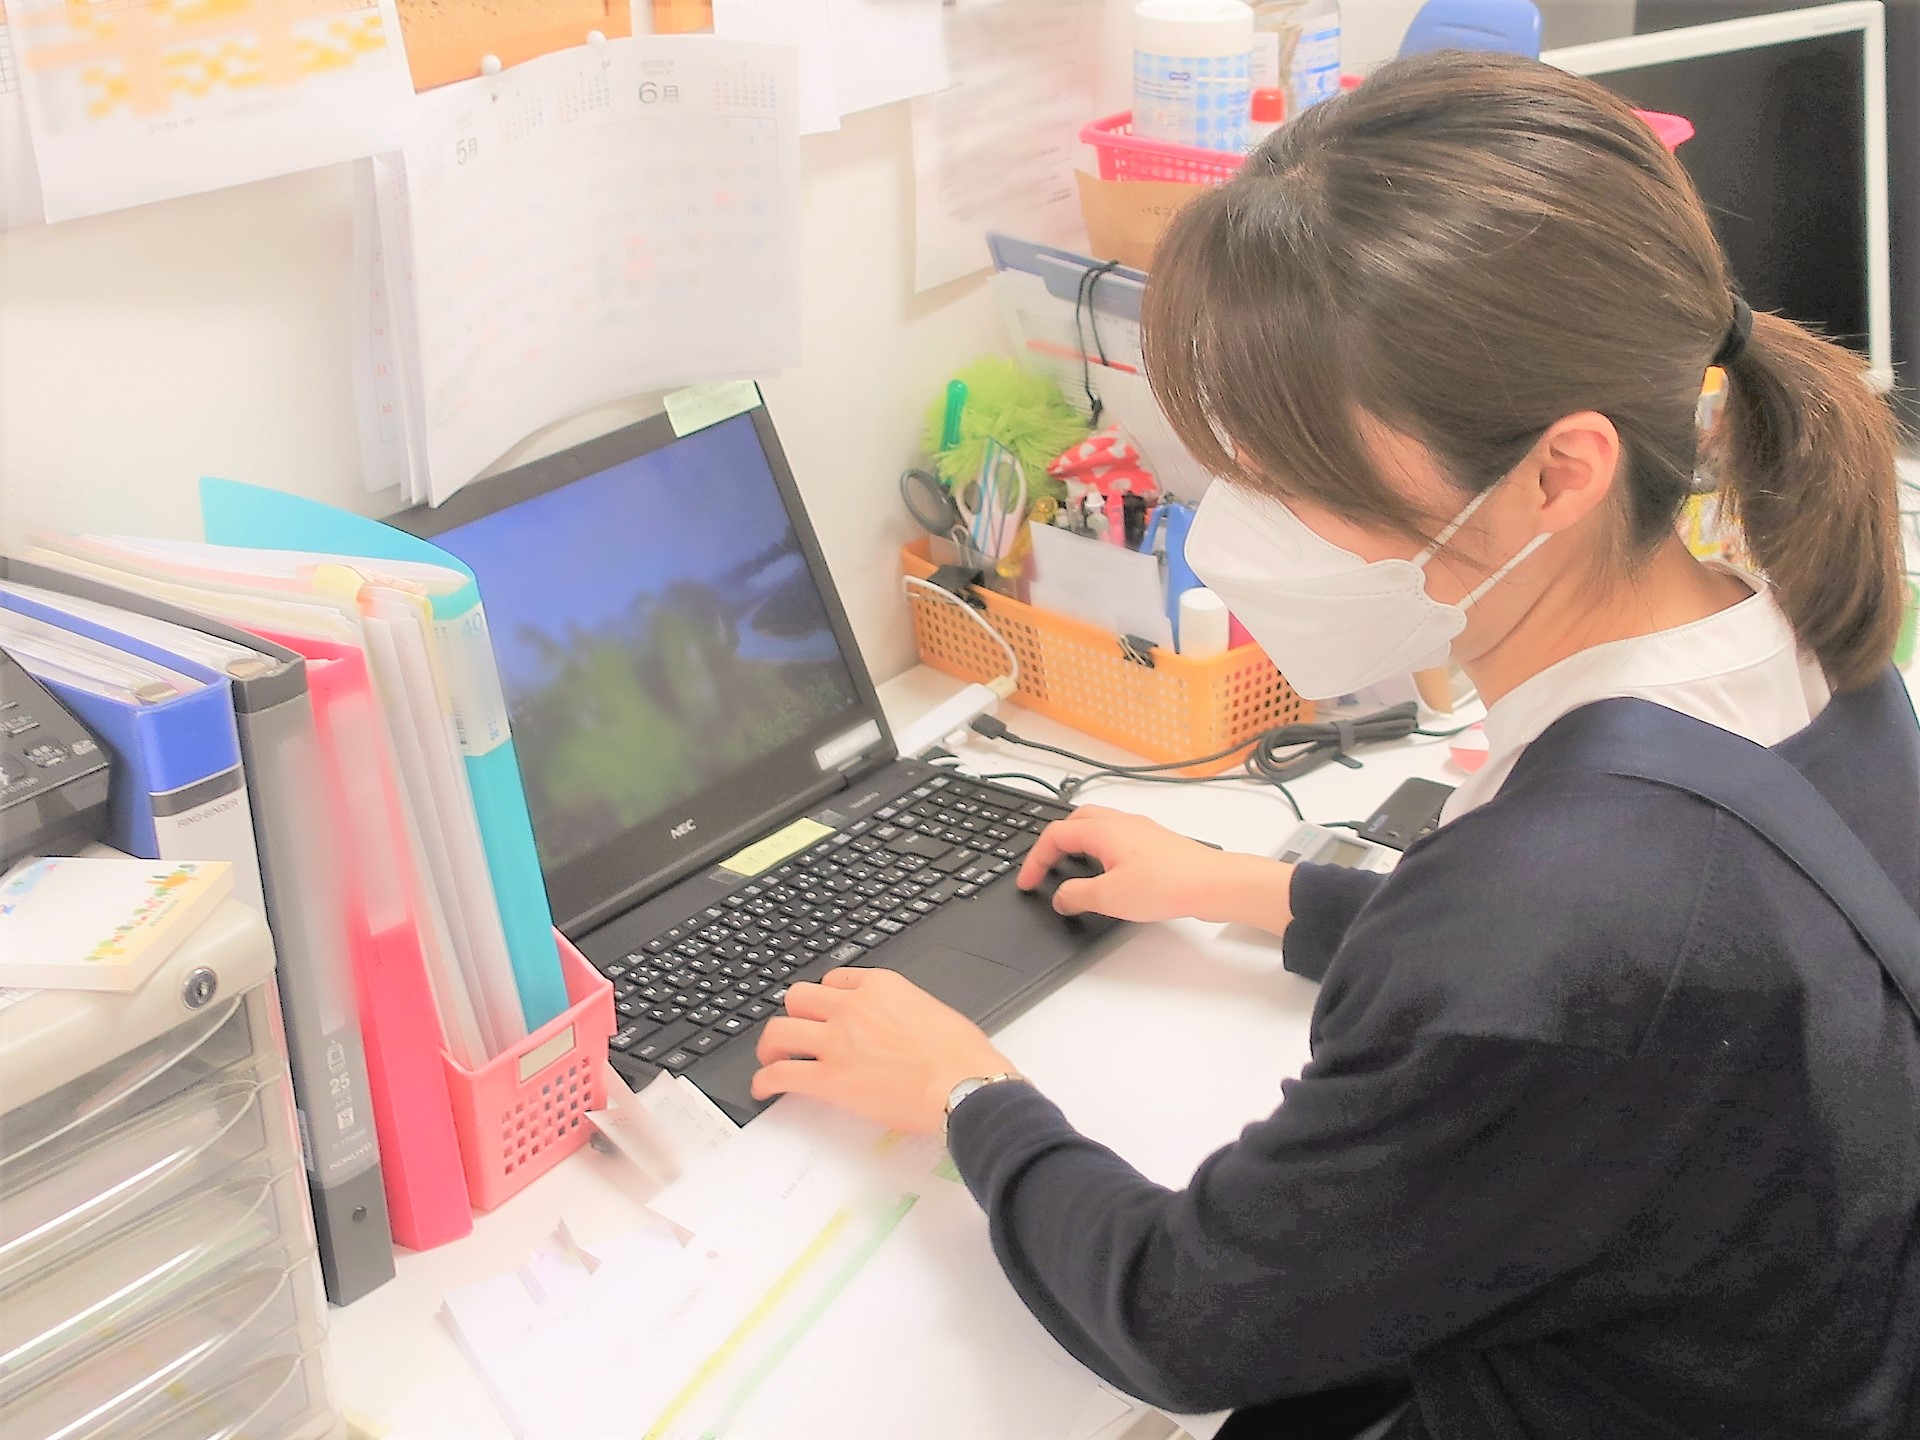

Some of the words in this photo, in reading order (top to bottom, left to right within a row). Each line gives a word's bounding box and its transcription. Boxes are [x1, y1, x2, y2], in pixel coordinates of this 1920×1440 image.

[638, 81, 680, 104] 6月
[455, 137, 479, 166] 5月
[462, 611, 483, 636] 40
[670, 818, 697, 840] NEC
[329, 1071, 351, 1095] 25
